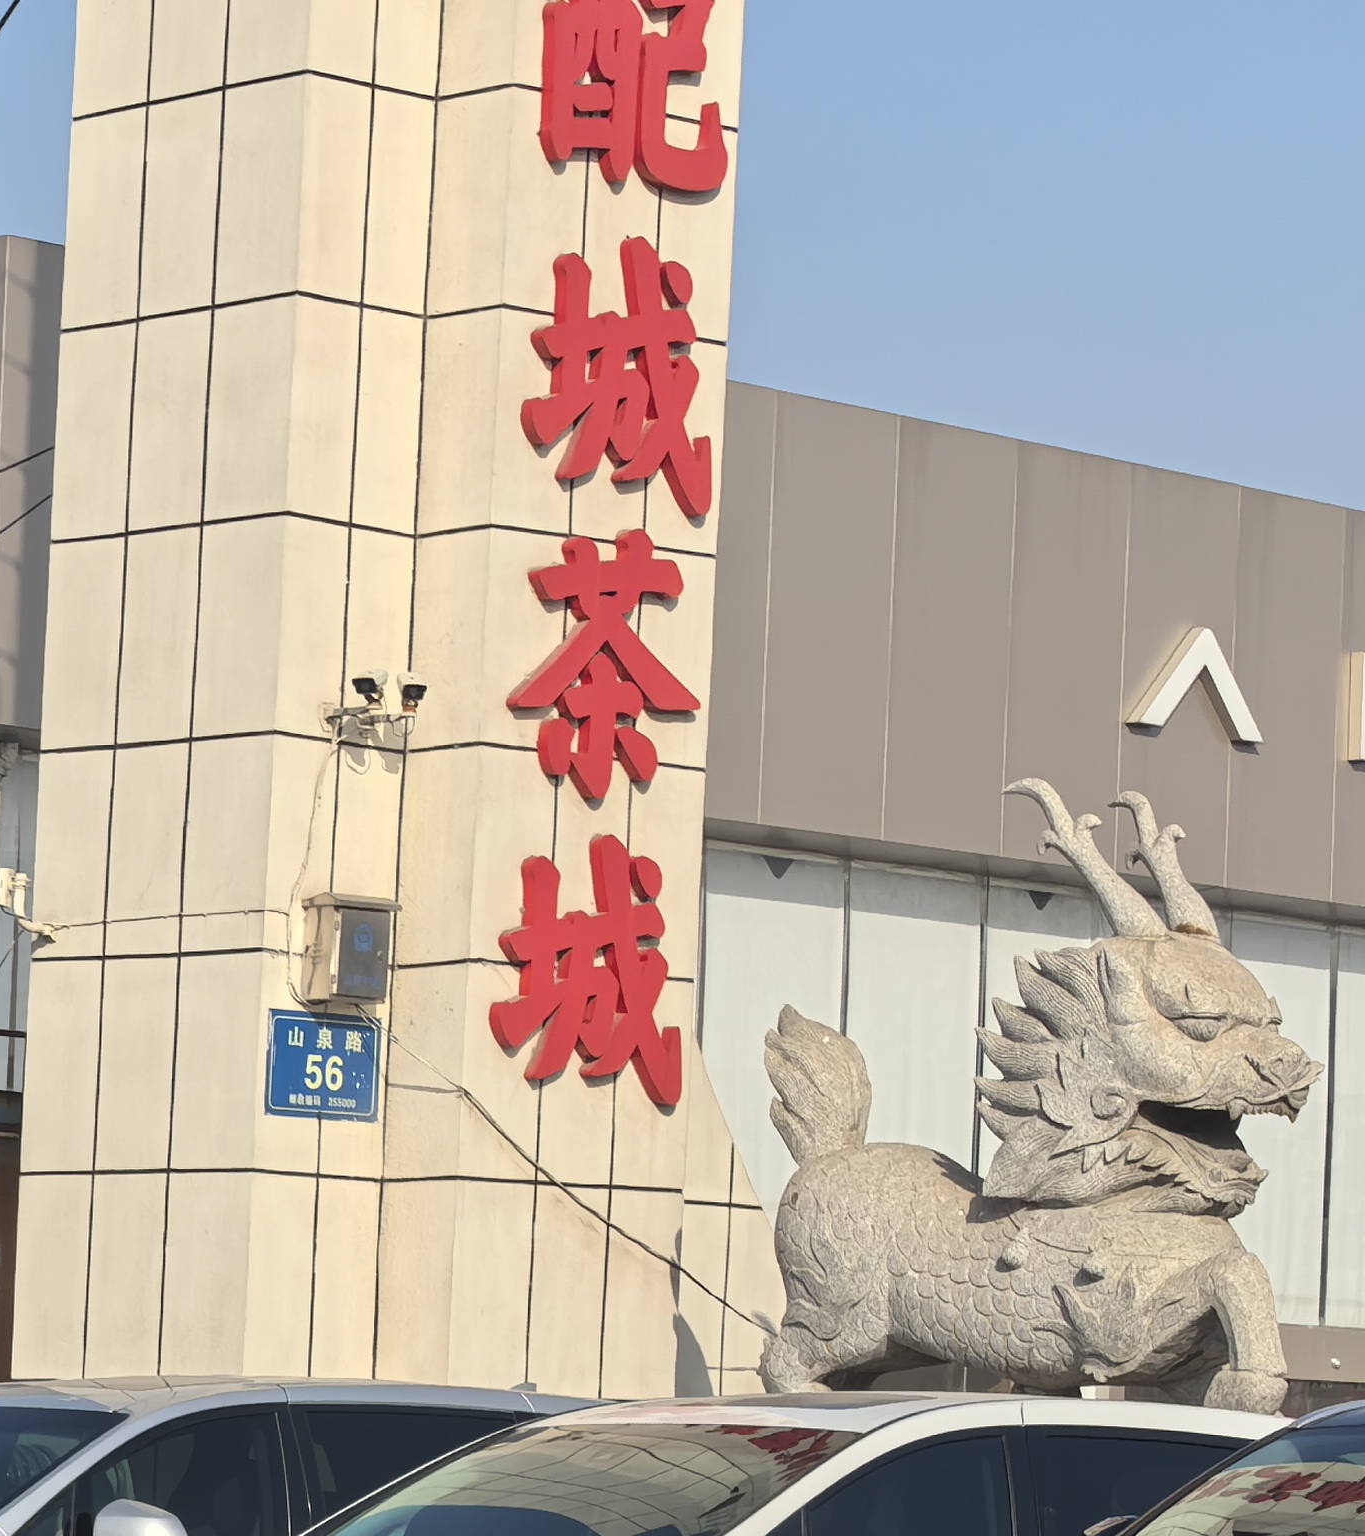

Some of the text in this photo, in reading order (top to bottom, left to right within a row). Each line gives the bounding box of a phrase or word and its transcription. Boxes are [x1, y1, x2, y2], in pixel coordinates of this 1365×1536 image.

[287, 1026, 363, 1053] 山泉路
[304, 1054, 344, 1091] 56
